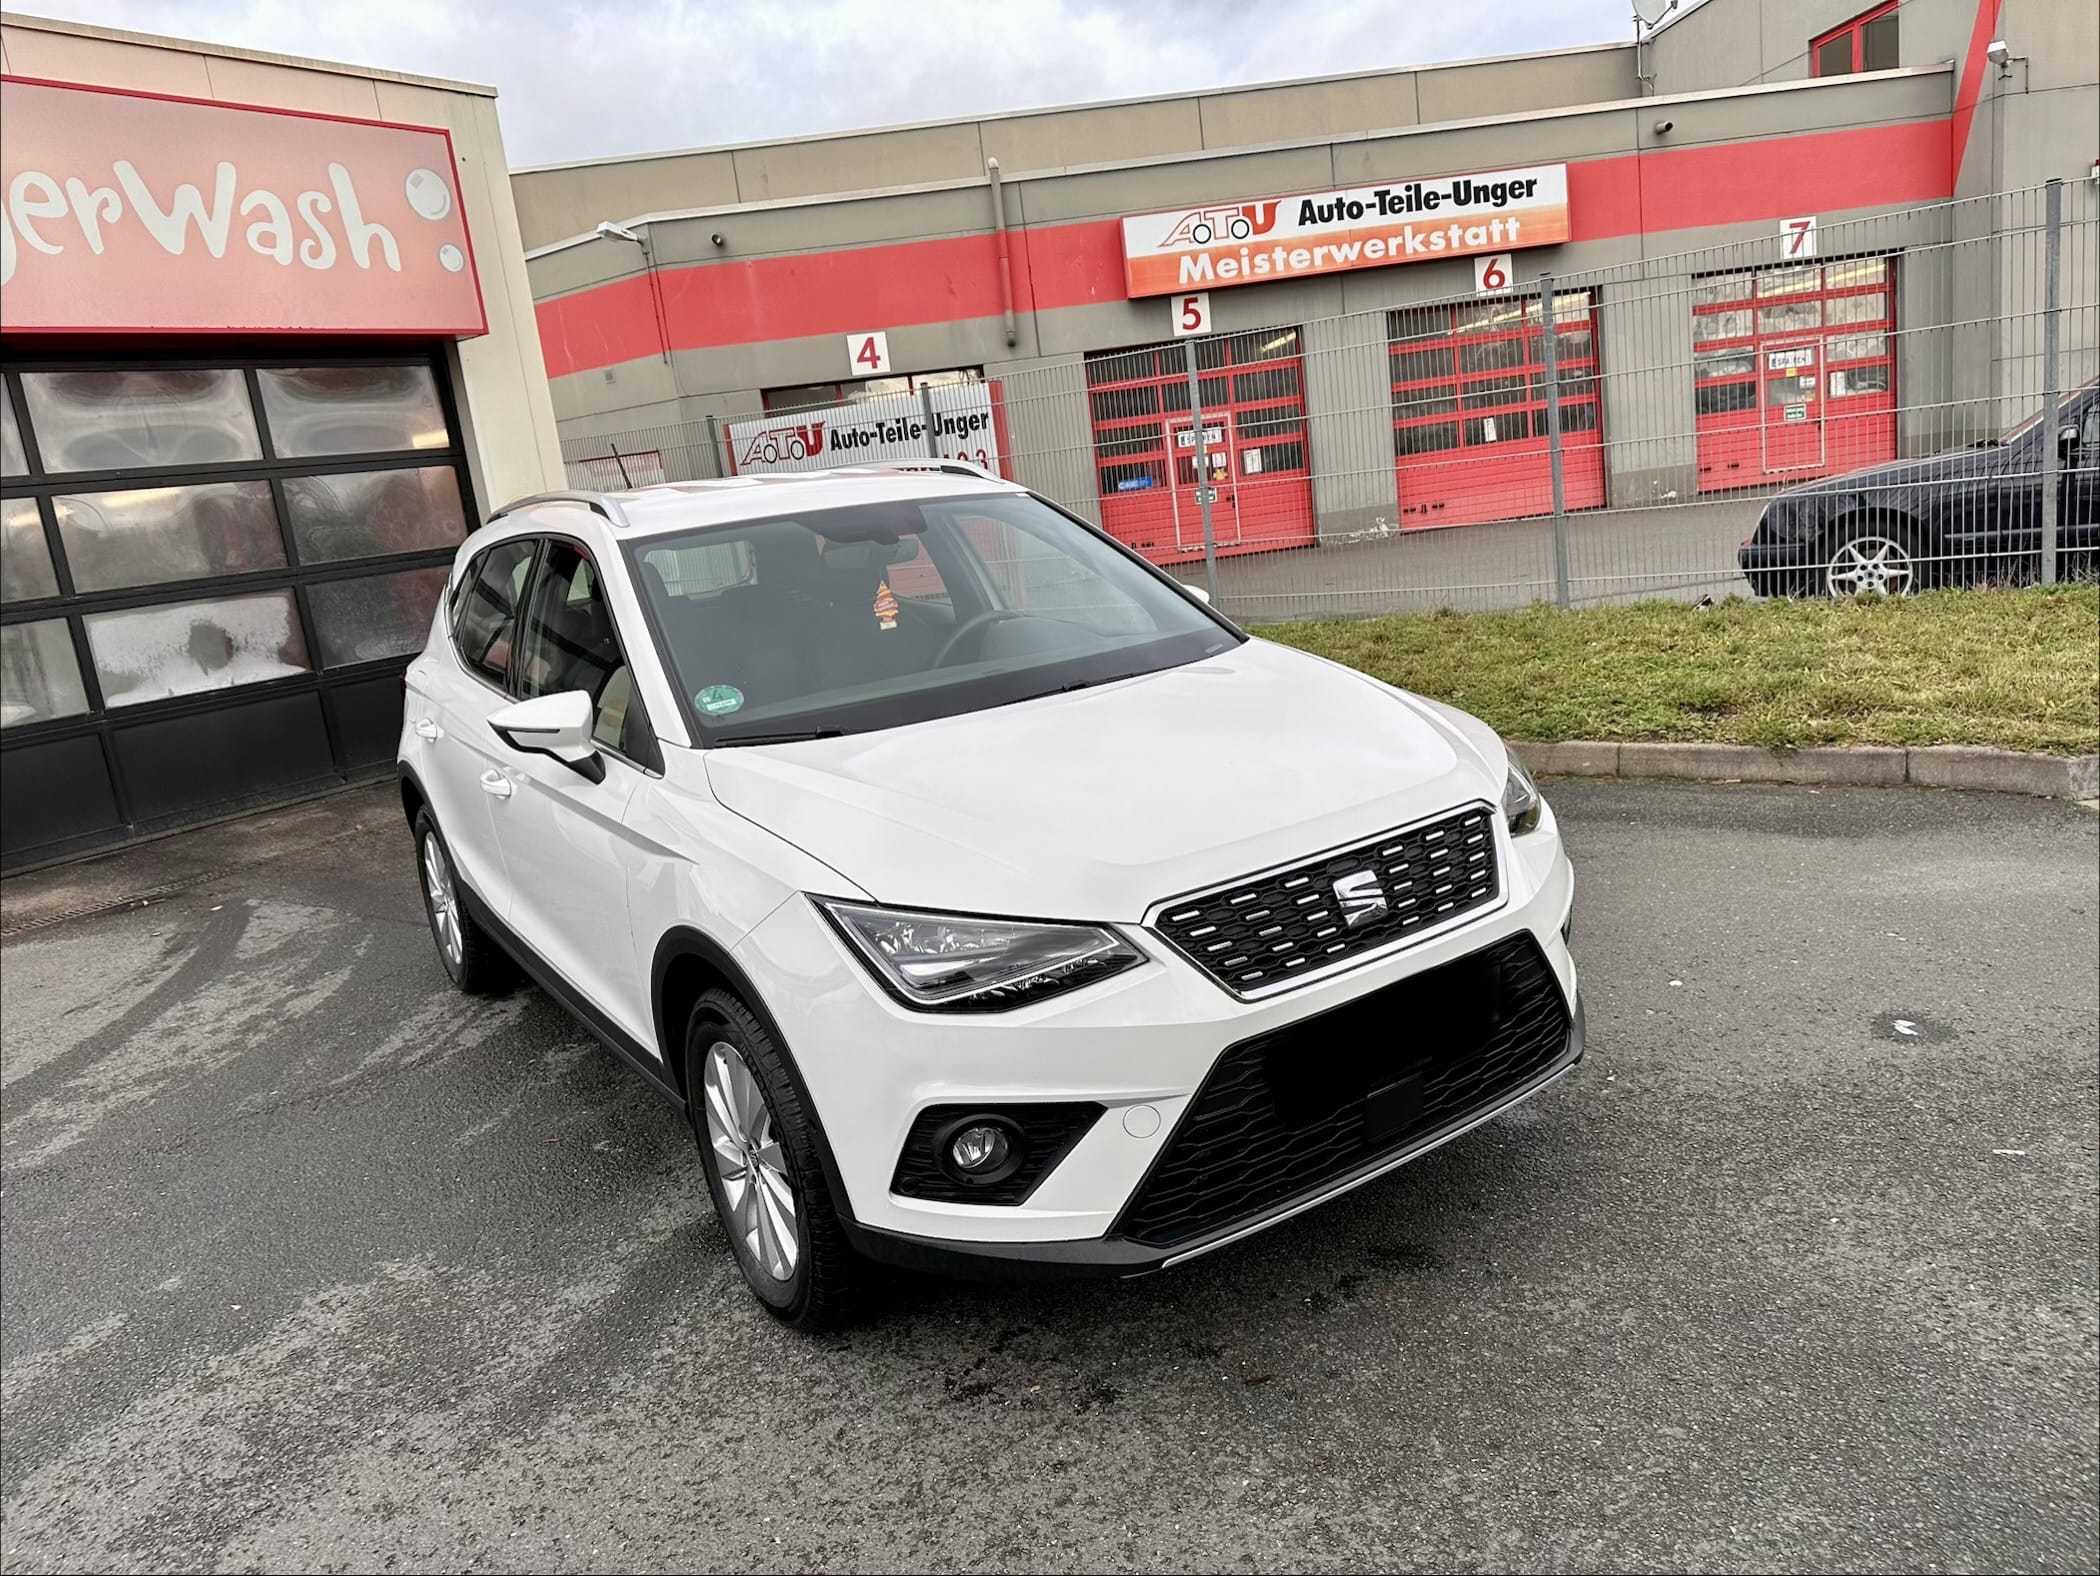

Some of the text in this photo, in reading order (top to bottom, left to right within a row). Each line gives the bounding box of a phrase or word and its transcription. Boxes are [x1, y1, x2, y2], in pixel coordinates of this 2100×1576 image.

[1298, 177, 1537, 226] Auto-Teile-Unger
[1178, 216, 1520, 285] Meisterwerkstatt
[1789, 221, 1811, 254] 7
[1482, 258, 1506, 290] 6
[1181, 297, 1202, 330] 5
[856, 337, 880, 369] 4
[830, 412, 989, 451] Auto-Teile-Unger
